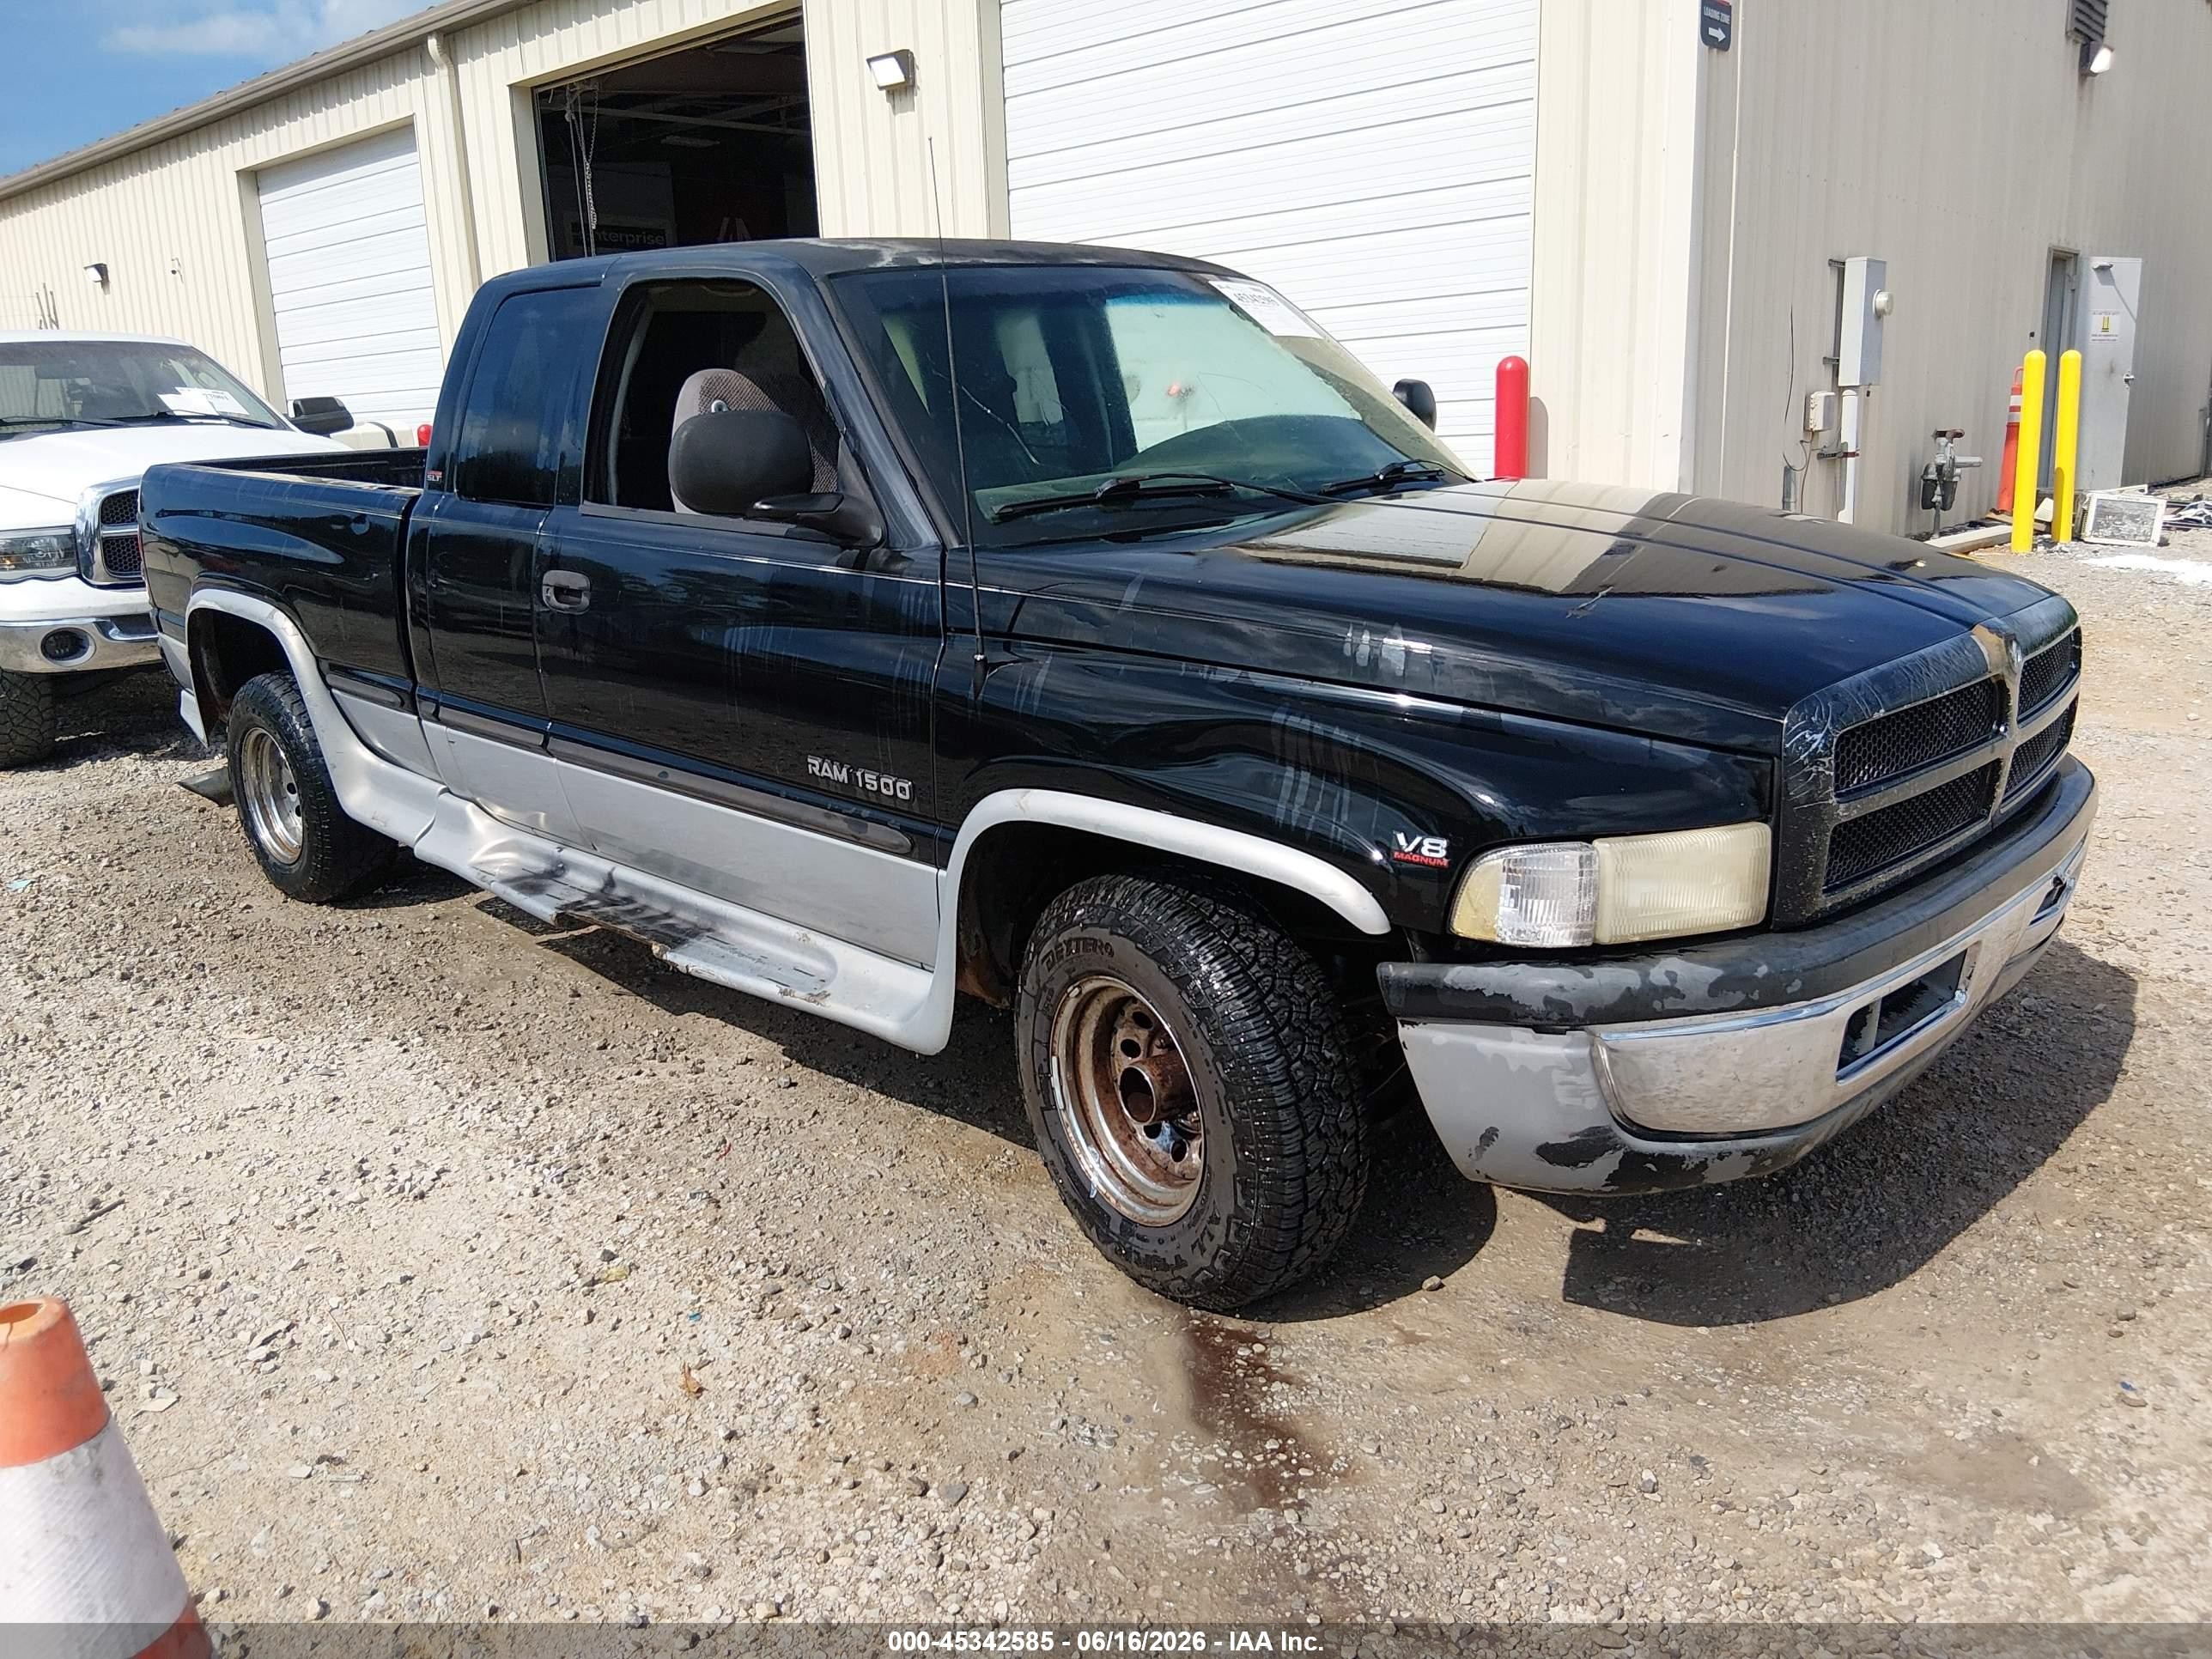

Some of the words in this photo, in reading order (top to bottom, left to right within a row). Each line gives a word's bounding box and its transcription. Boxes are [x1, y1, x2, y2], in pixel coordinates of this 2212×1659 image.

[806, 754, 851, 785] RAM
[855, 768, 913, 801] 1500
[1392, 830, 1449, 859] V8
[1393, 851, 1449, 868] MAGNUM
